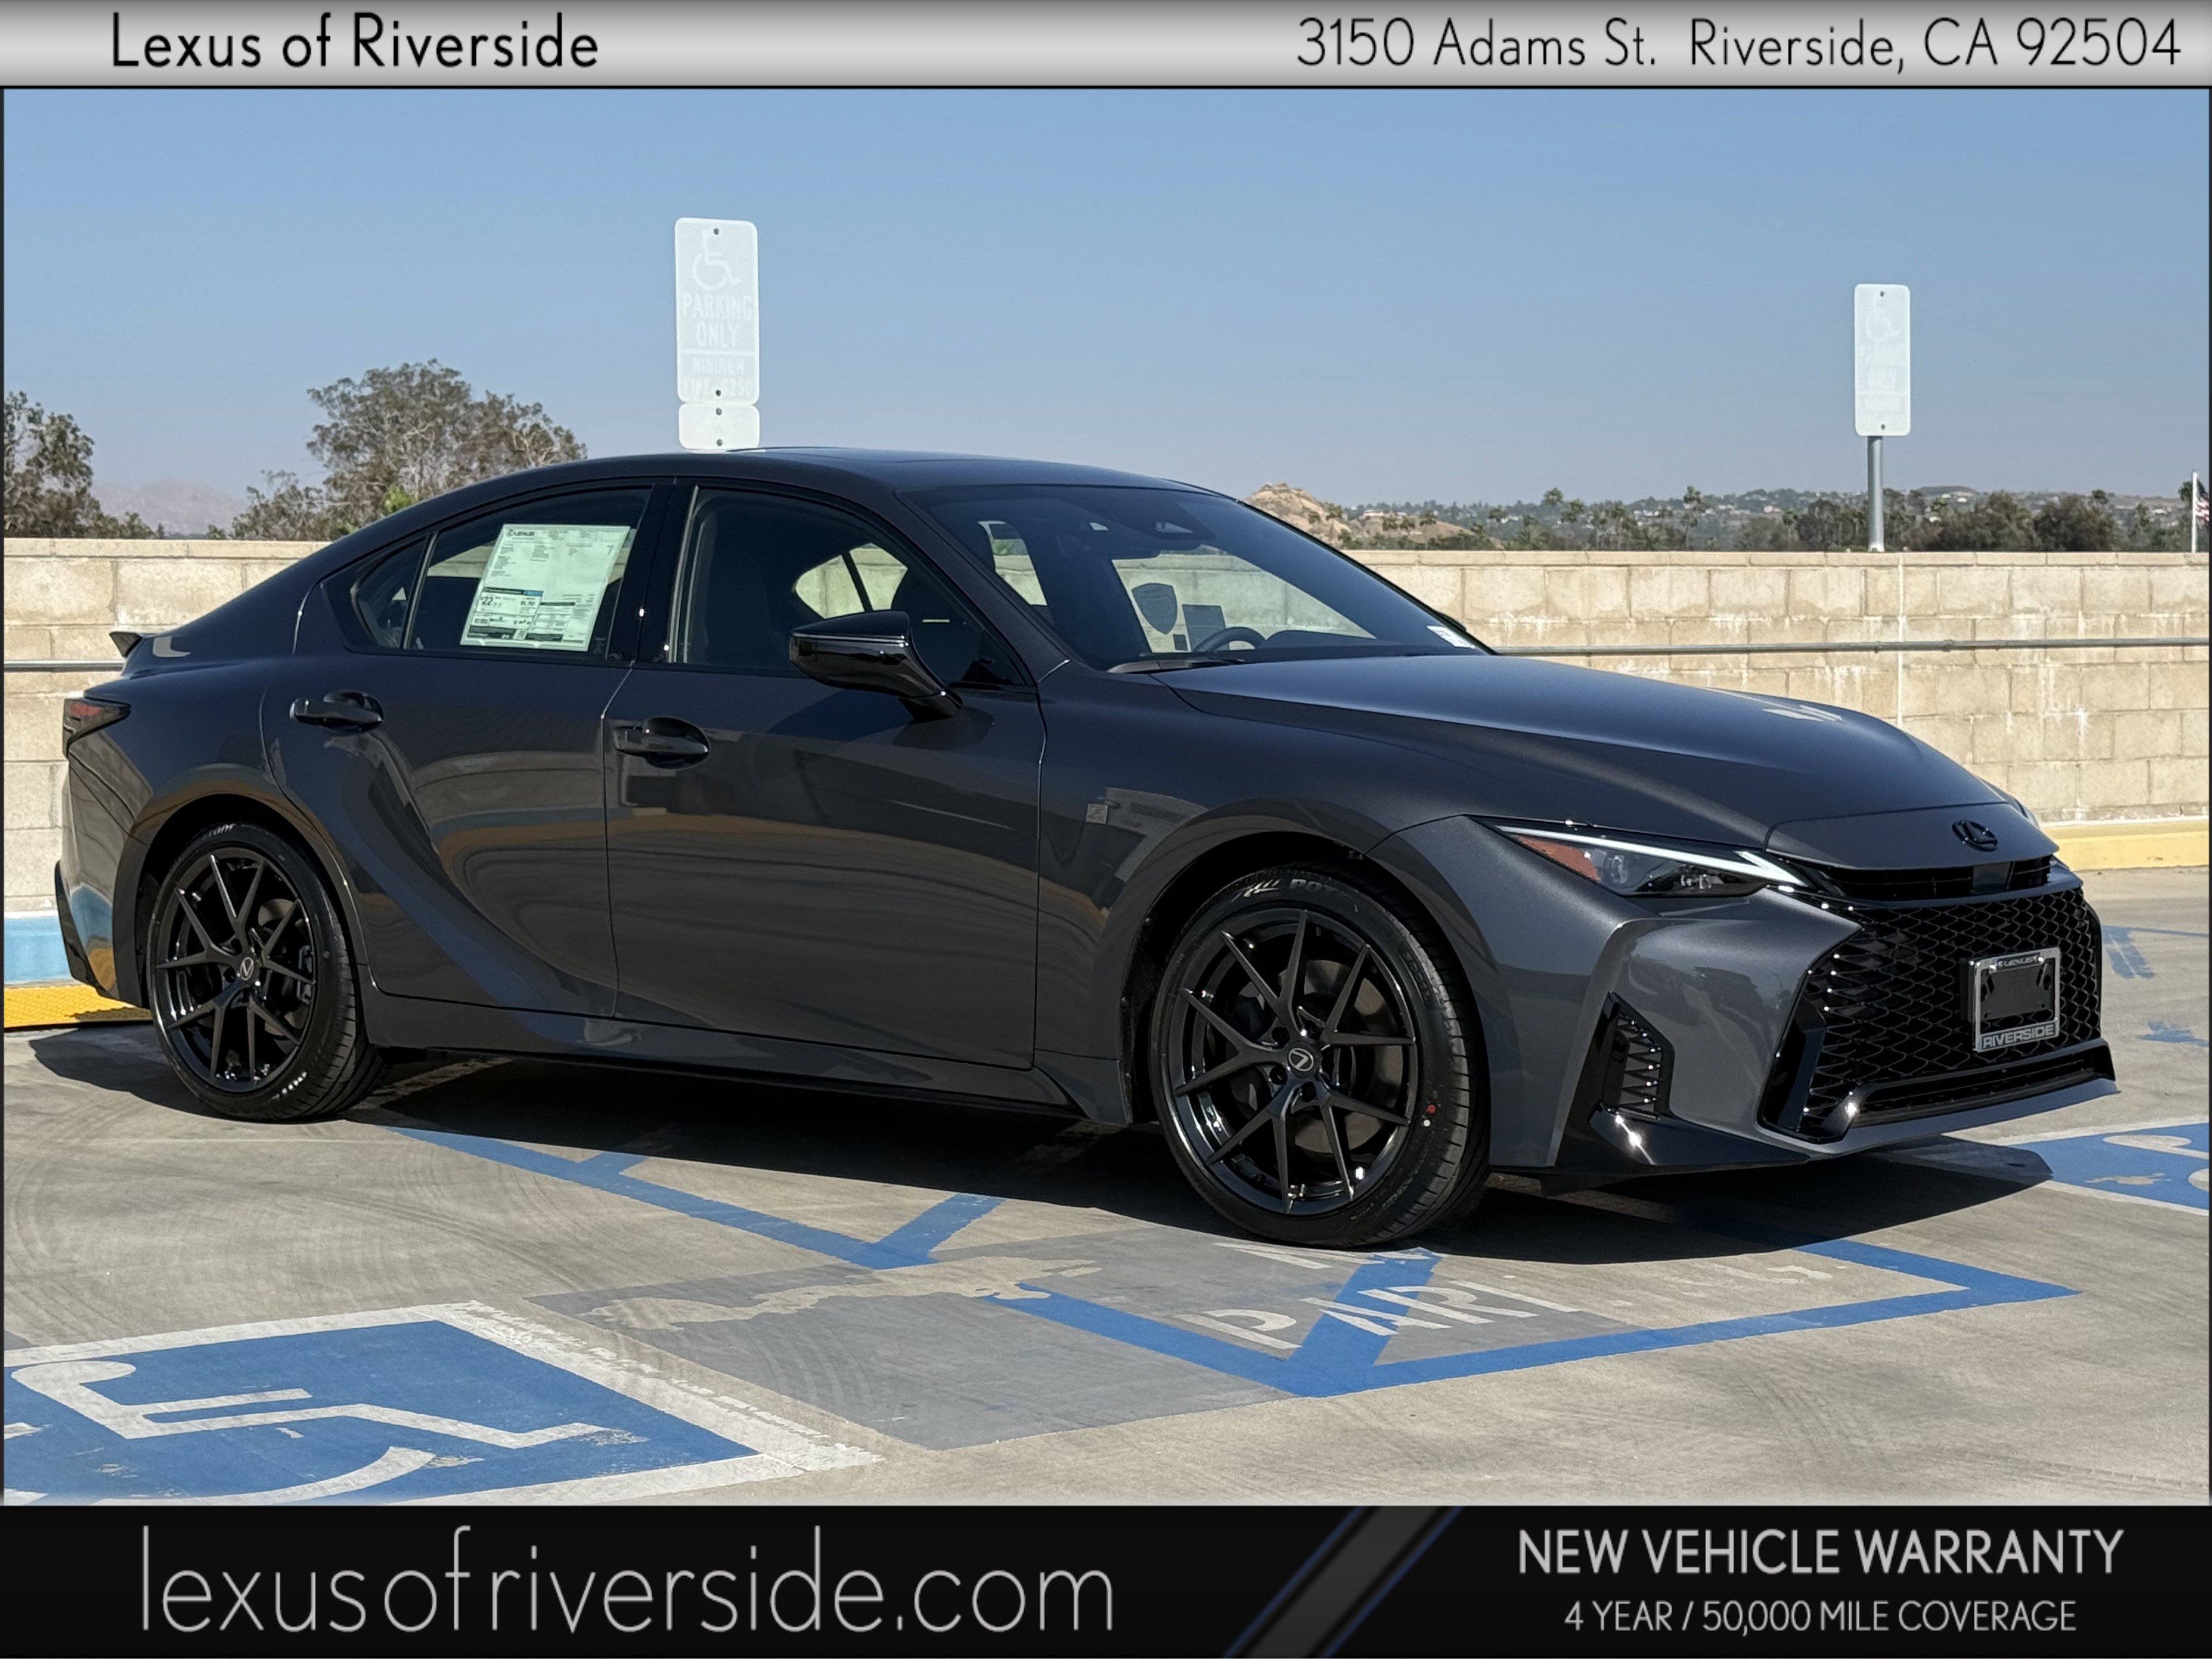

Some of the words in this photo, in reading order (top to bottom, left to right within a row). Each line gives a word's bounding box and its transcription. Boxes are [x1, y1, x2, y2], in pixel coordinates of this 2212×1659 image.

[682, 292, 753, 321] PARKING
[696, 321, 740, 349] ONLY
[1982, 1024, 2055, 1049] RIVERSIDE
